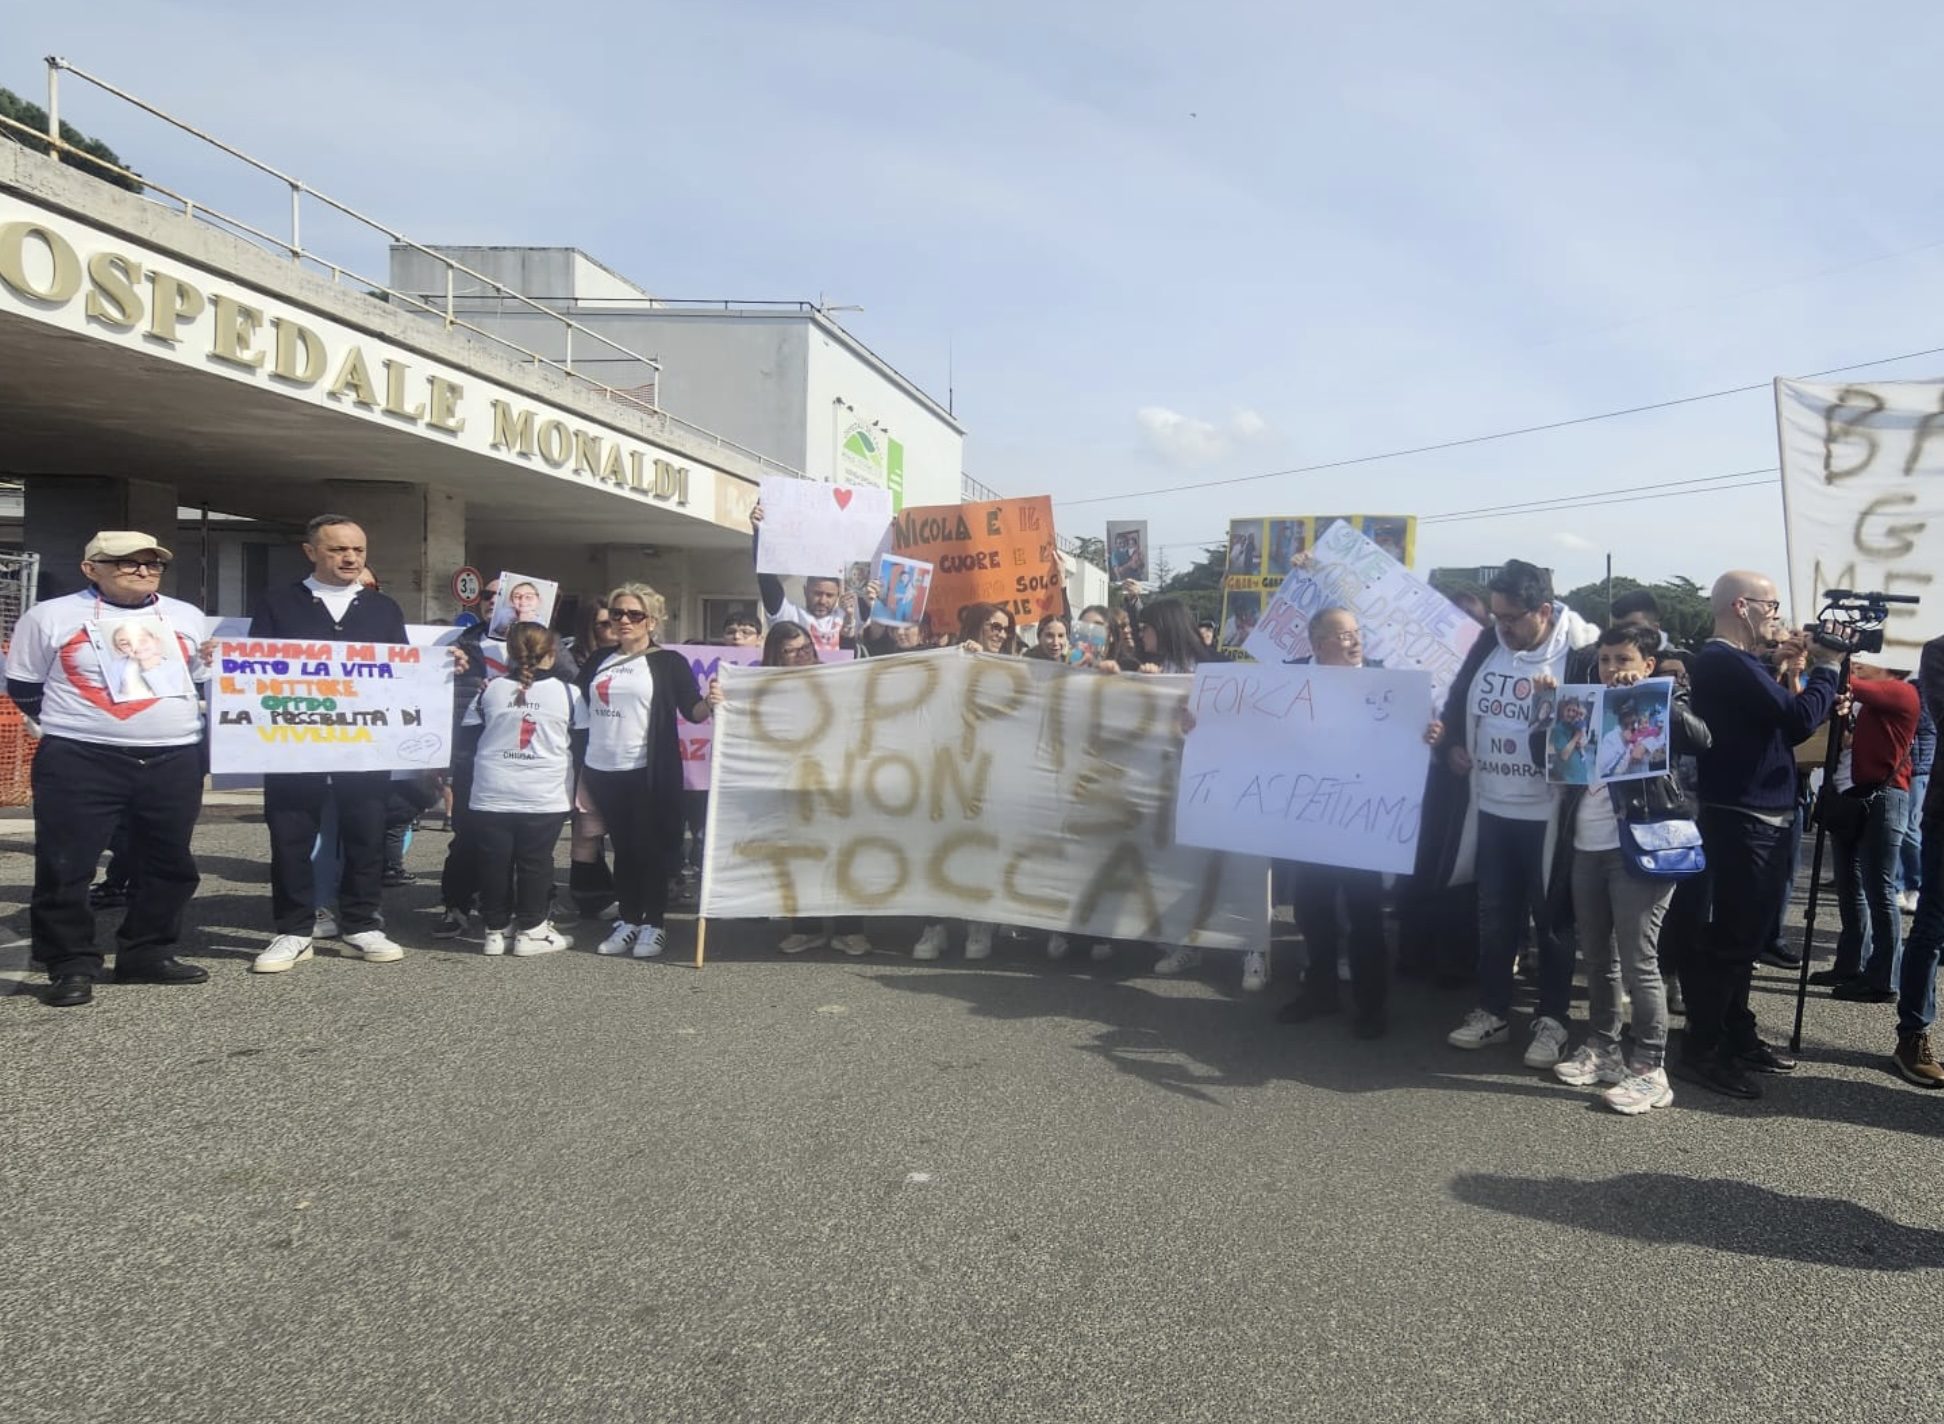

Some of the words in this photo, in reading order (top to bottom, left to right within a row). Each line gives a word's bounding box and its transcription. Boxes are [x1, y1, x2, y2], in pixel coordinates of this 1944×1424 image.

[0, 220, 466, 432] OSPEDALE
[490, 398, 691, 506] MONALDI
[894, 512, 973, 548] NICOLA
[1015, 574, 1059, 593] SOLO
[221, 642, 333, 661] MAMMA
[388, 645, 420, 664] HA
[222, 659, 290, 676] DATO
[301, 662, 331, 677] LA
[256, 679, 358, 698] DOTTORE
[1481, 672, 1532, 701] STO
[219, 711, 253, 726] LA
[750, 660, 1182, 771] OPPID
[1478, 698, 1530, 721] GOGN
[795, 745, 993, 824] NON
